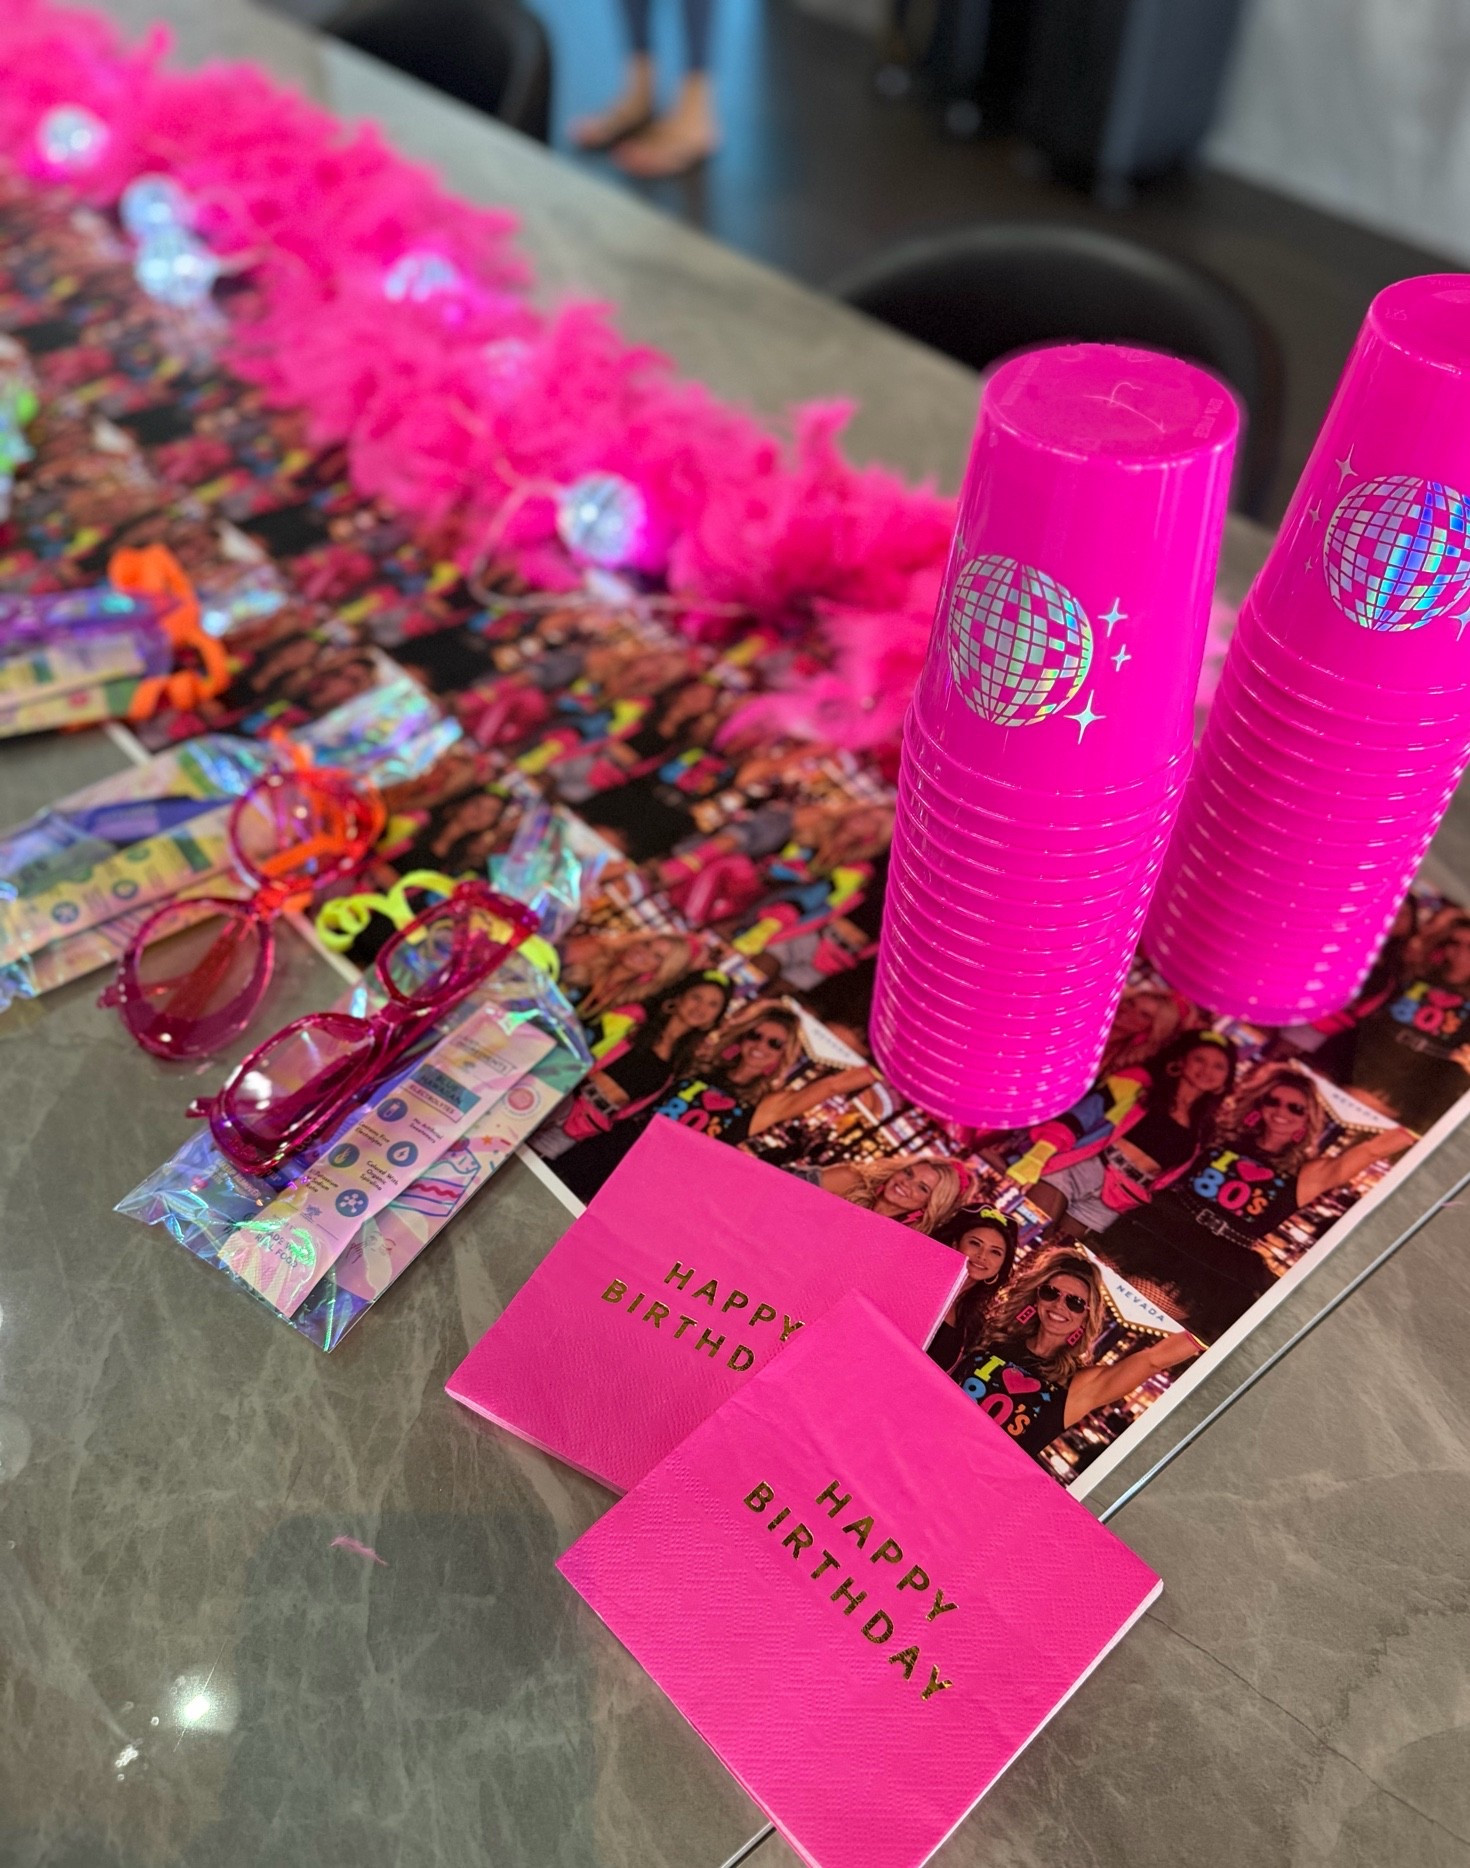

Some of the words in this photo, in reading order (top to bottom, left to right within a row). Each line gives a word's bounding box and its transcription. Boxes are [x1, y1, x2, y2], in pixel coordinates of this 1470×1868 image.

[409, 1083, 455, 1116] ELECTROLYTES
[365, 1159, 388, 1176] Colored
[385, 1173, 399, 1186] With
[365, 1167, 387, 1185] Organic
[1210, 1150, 1240, 1174] I
[1193, 1168, 1269, 1216] 80's
[265, 1227, 286, 1245] ADE
[663, 1260, 805, 1342] HAPPY
[1116, 1284, 1165, 1322] NEVADA
[601, 1278, 755, 1372] BIRTHD
[973, 1355, 1006, 1382] I
[815, 1479, 959, 1622] HAPPY
[743, 1480, 953, 1701] BIRTHDAY
